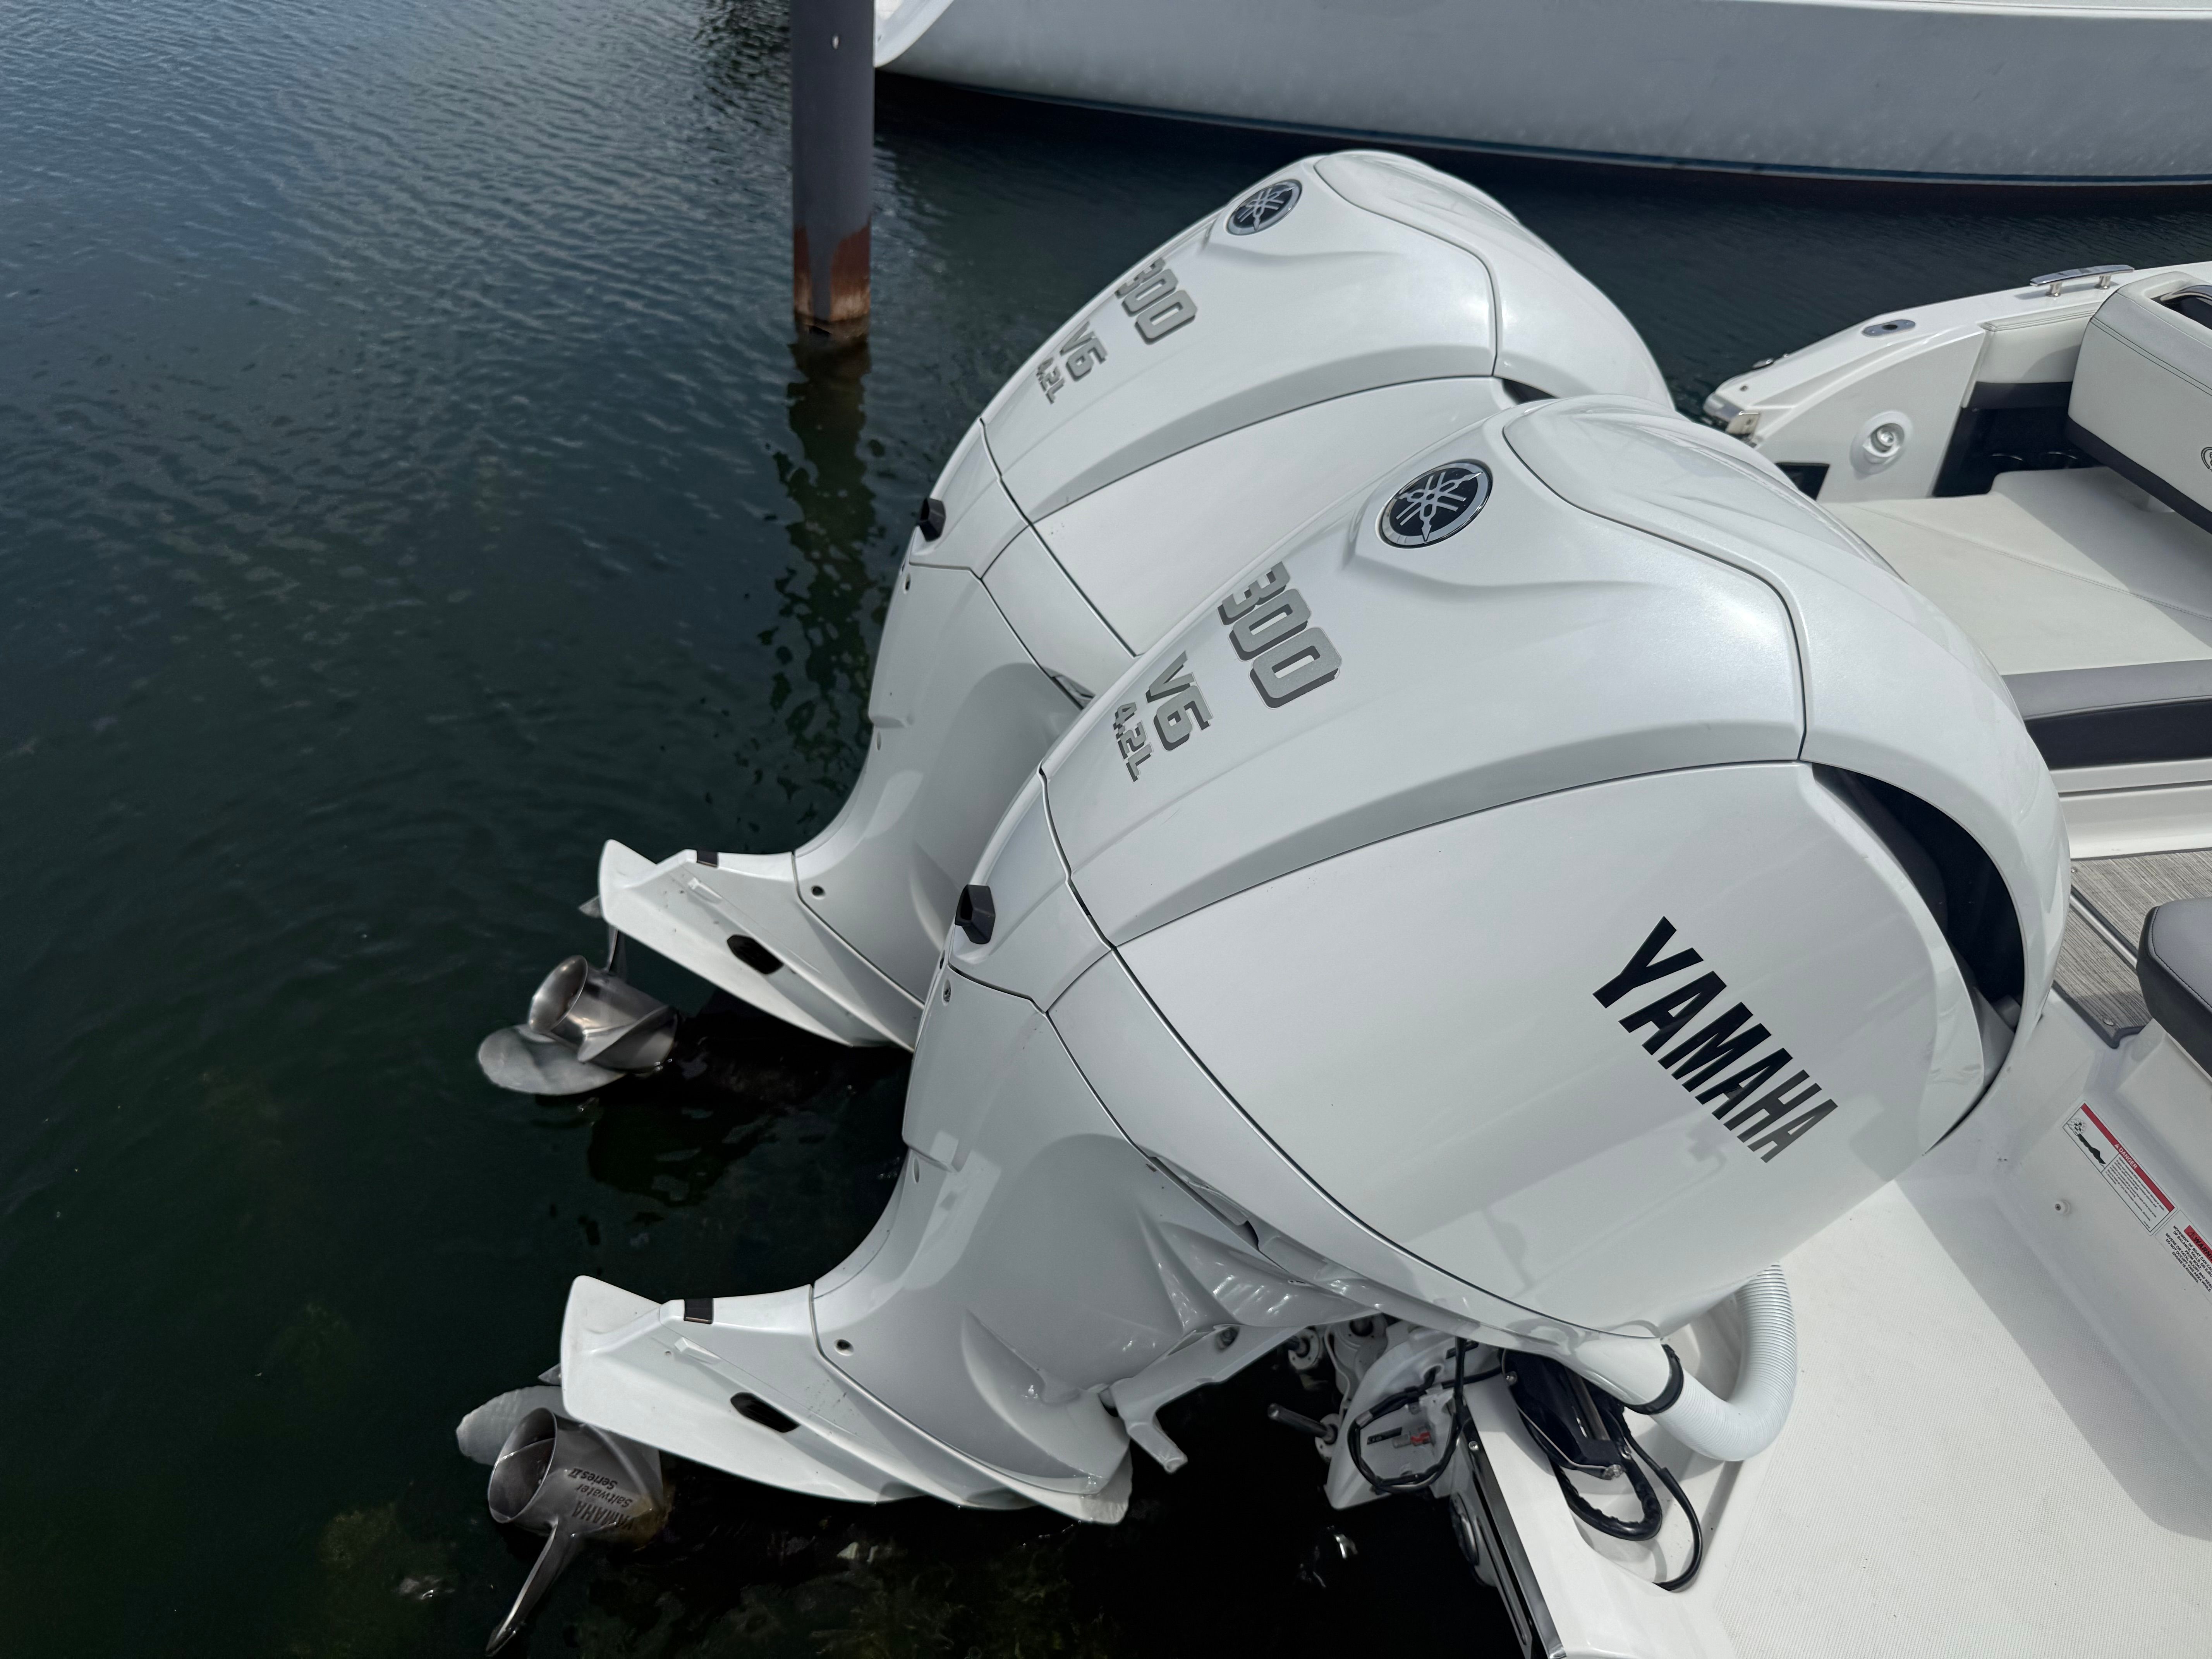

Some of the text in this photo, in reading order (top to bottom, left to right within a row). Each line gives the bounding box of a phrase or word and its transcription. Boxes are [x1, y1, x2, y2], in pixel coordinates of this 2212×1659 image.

[1115, 257, 1197, 345] 300
[1060, 321, 1108, 382] V6
[1217, 561, 1343, 709] 300
[1145, 650, 1213, 751] V6
[1113, 702, 1154, 782] 4.2L
[1592, 916, 1838, 1163] YAMAHA
[2119, 1147, 2137, 1169] DANGER
[576, 1484, 633, 1507] Saltwater
[582, 1470, 618, 1490] Series
